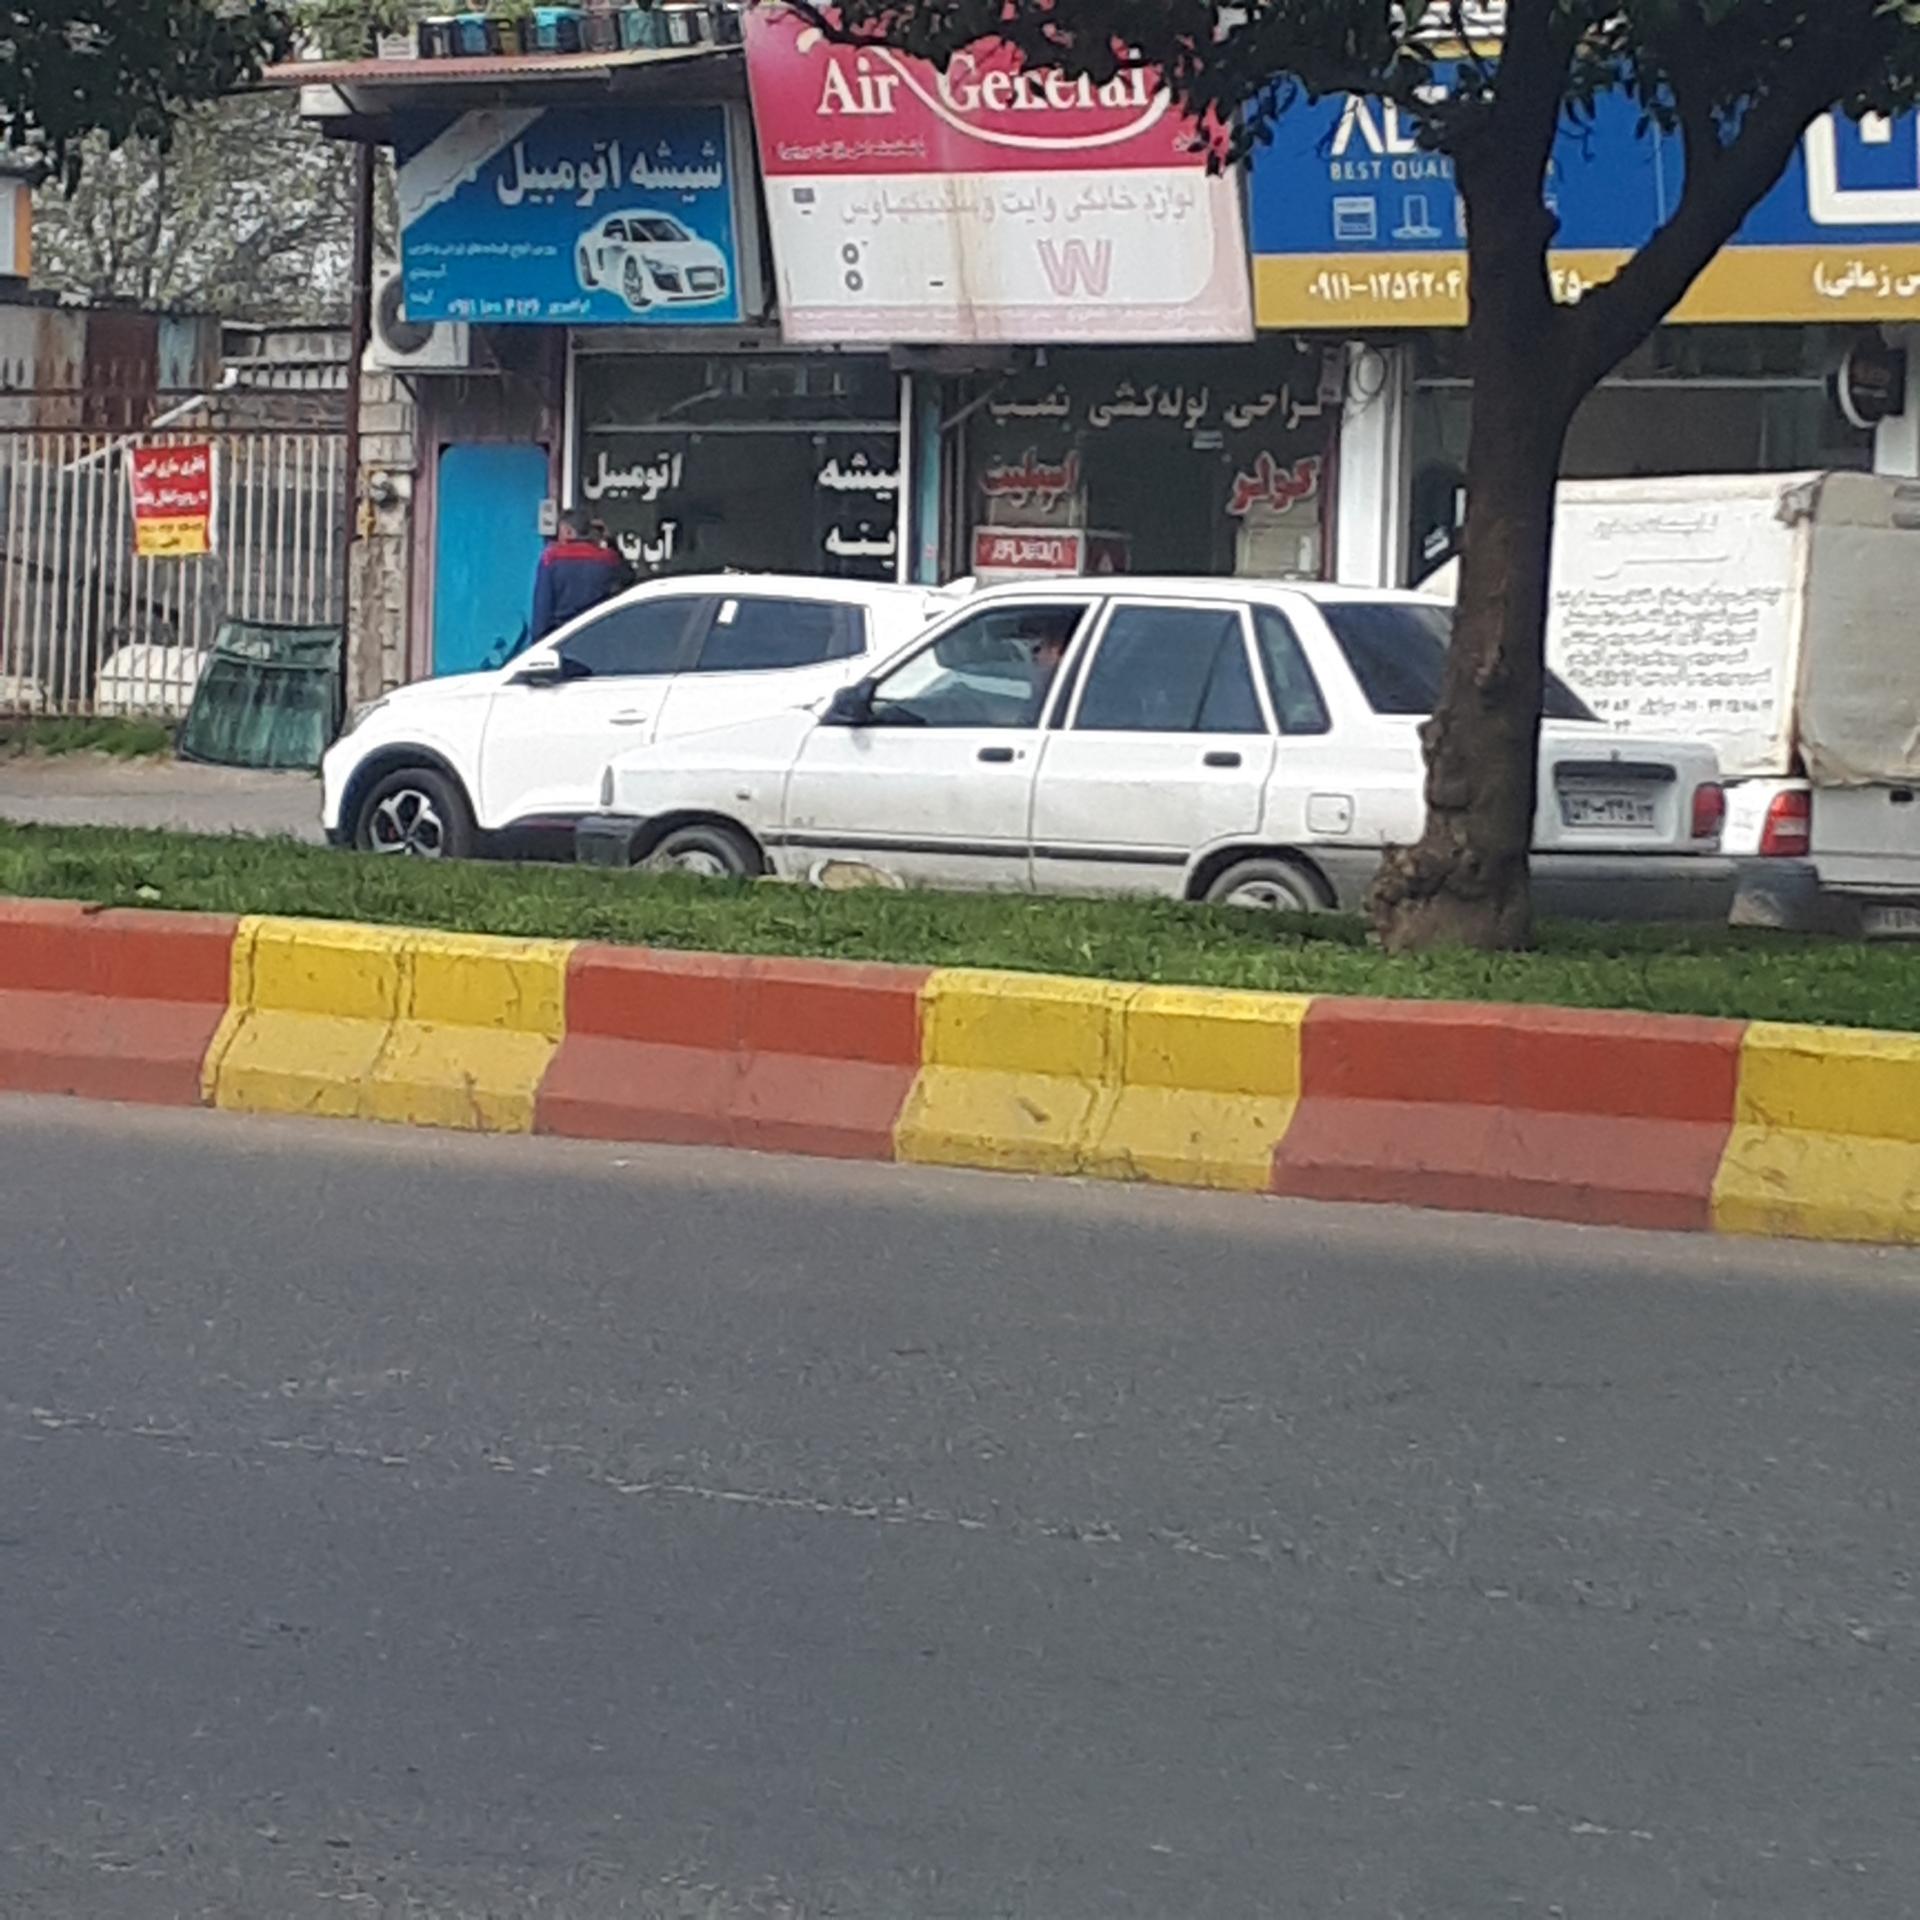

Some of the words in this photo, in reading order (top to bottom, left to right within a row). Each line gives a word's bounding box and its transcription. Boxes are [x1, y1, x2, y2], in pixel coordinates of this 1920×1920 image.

[817, 58, 898, 114] Air
[497, 139, 621, 207] اتومبیل
[629, 140, 723, 203] شیشه
[1330, 160, 1382, 180] BEST
[1223, 383, 1321, 429] راحی
[583, 452, 683, 501] اتومبیل
[1226, 451, 1321, 516] کولر
